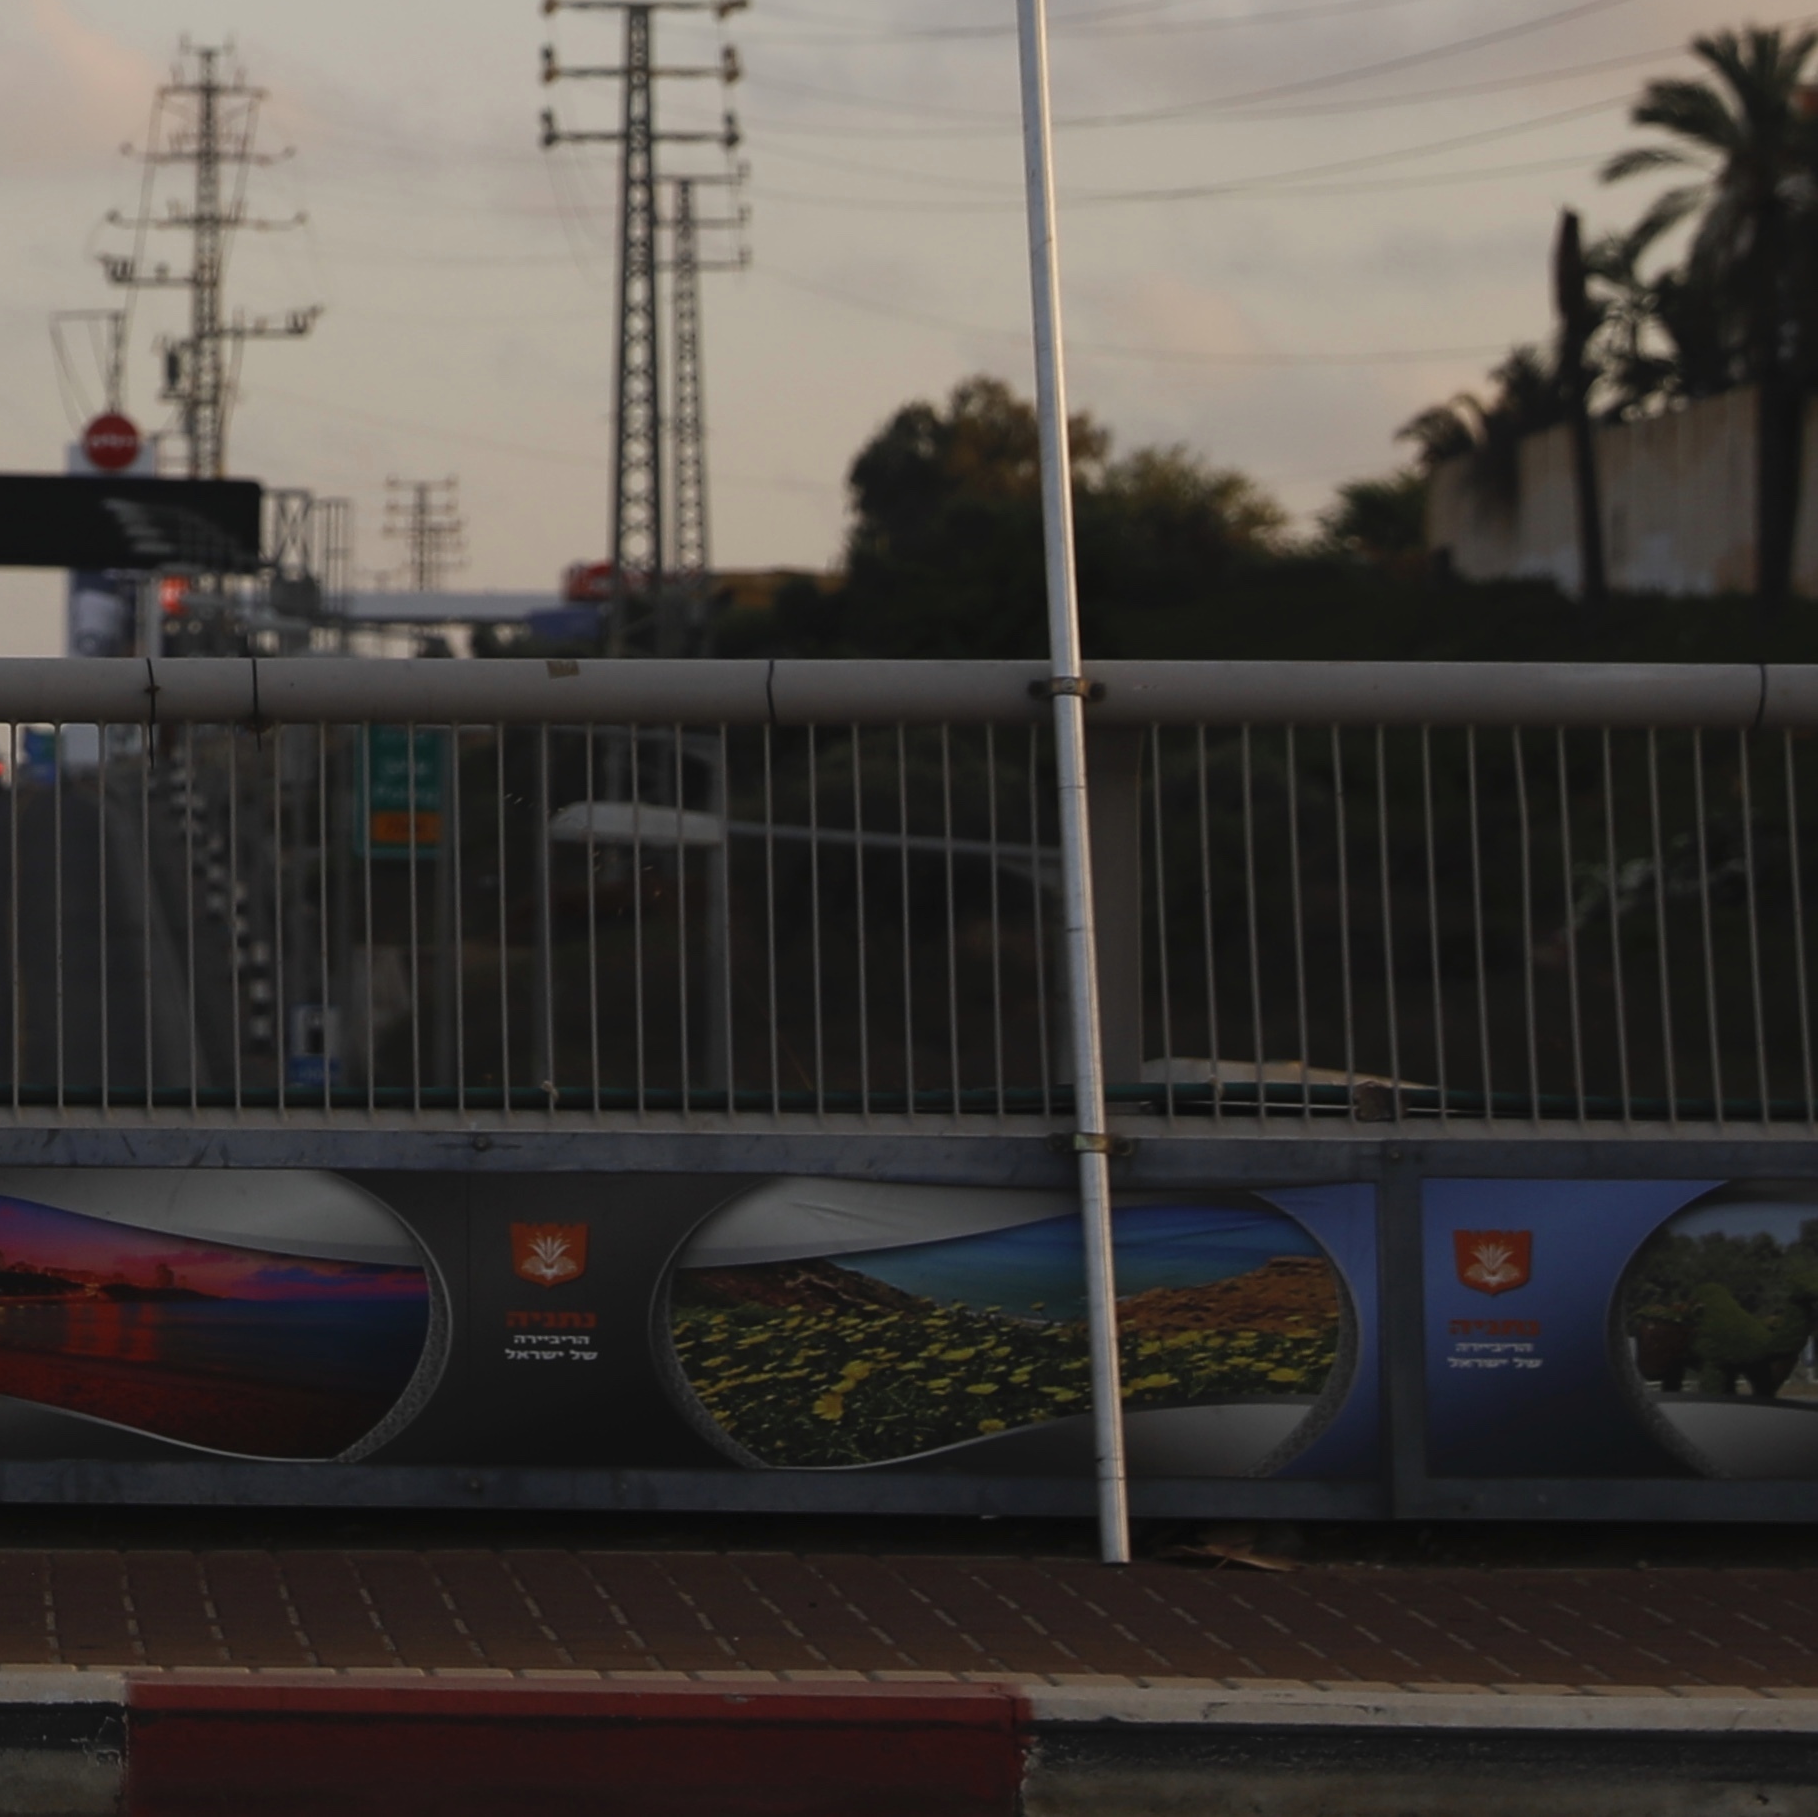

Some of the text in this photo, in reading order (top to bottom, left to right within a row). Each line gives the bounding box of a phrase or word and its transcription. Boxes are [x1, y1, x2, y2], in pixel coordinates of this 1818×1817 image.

[505, 1310, 598, 1328] נתניה
[1449, 1319, 1541, 1335] נתניה
[513, 1334, 590, 1345] הריביירה
[505, 1349, 598, 1361] של ישראל
